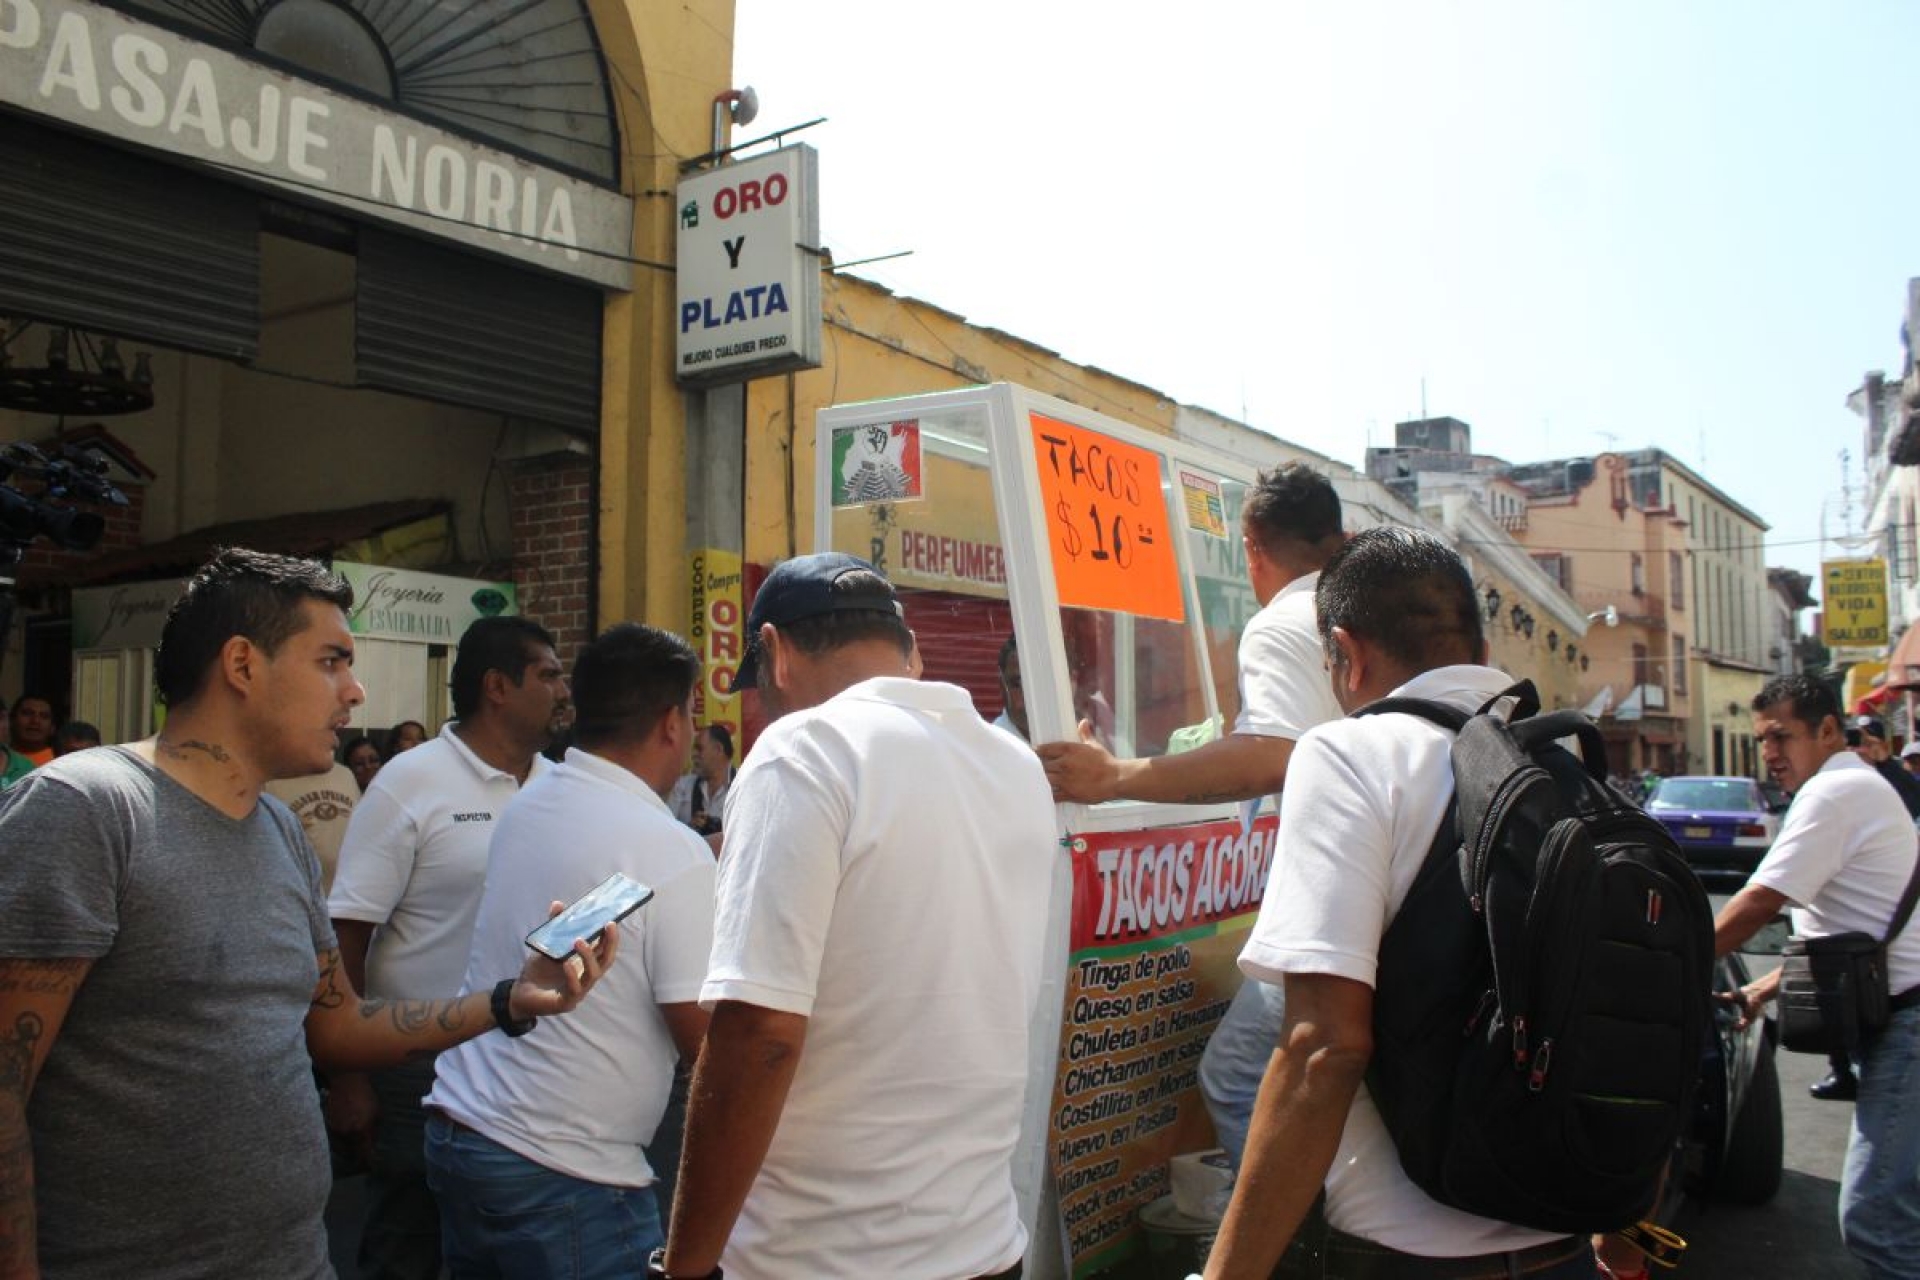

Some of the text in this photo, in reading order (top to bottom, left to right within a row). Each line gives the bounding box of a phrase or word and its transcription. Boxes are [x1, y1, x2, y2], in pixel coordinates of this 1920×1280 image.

[370, 123, 579, 260] NORIA
[713, 173, 788, 219] ORO
[723, 236, 745, 269] Y
[681, 282, 789, 333] PLATA
[683, 334, 786, 365] MEJORO CUALQUIER PRECIO
[1040, 434, 1140, 507] TACOS
[369, 607, 451, 637] ESMERALDA
[1836, 597, 1876, 611] VIDA
[1849, 613, 1859, 625] Y
[710, 598, 739, 696] ORO
[1828, 627, 1879, 640] SALUD
[1094, 841, 1195, 938] TACOS
[1079, 945, 1190, 991] Tinga de pollo
[1074, 980, 1195, 1024] Queso en salsa
[1070, 1028, 1137, 1060] Chuleta
[1140, 1024, 1150, 1044] a
[1153, 1016, 1166, 1039] la
[1157, 1050, 1176, 1068] en
[1060, 1091, 1133, 1131] Costillita
[1136, 1086, 1155, 1107] en
[1059, 1132, 1106, 1165] Huevo
[1110, 1125, 1131, 1147] en
[1106, 1183, 1126, 1206] en
